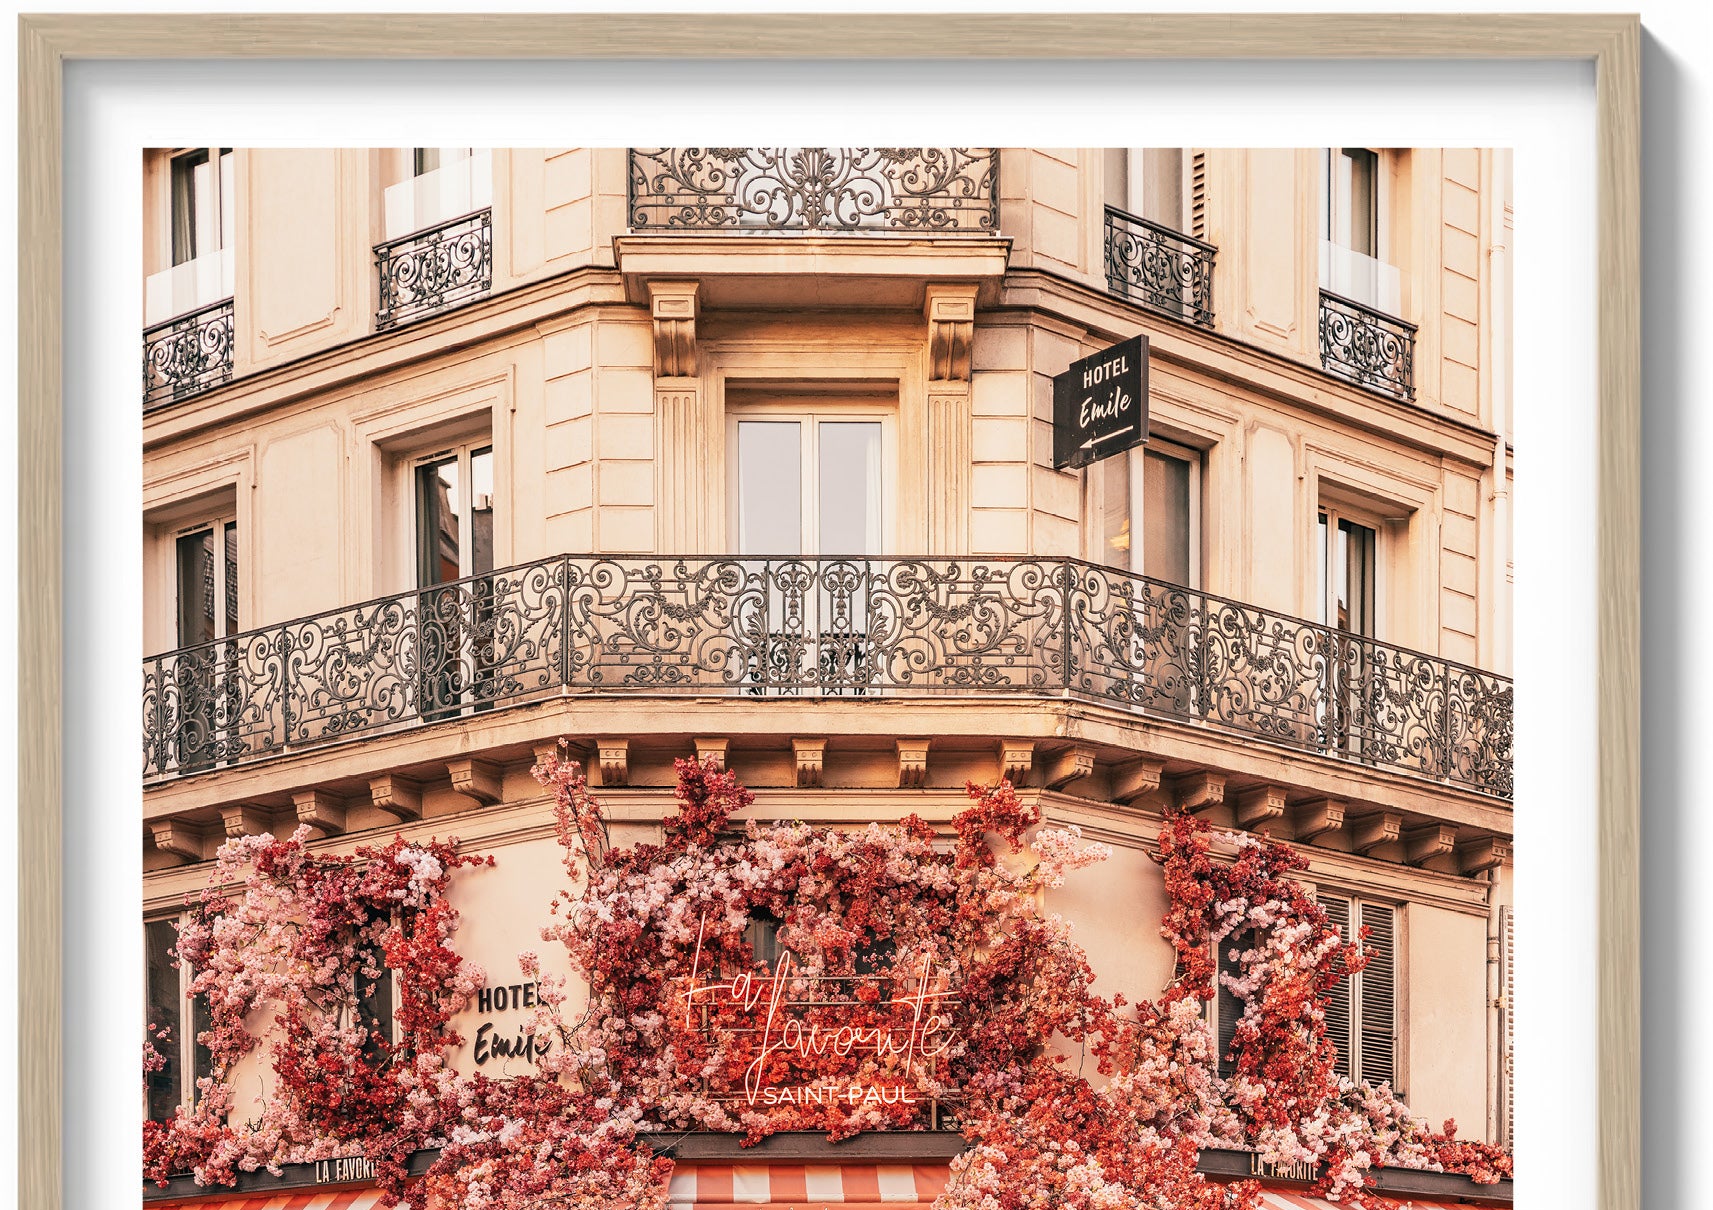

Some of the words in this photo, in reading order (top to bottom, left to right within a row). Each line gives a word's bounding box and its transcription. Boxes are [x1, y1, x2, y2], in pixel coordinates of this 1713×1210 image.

[1083, 355, 1129, 389] HOTEL
[1079, 385, 1132, 428] Emile
[681, 910, 764, 1029] La
[763, 1085, 916, 1105] SAINT-PAUL
[315, 1160, 330, 1183] LA
[336, 1157, 379, 1181] FAVORI
[1251, 1153, 1265, 1176] LA
[1271, 1158, 1319, 1180] FAORITE
